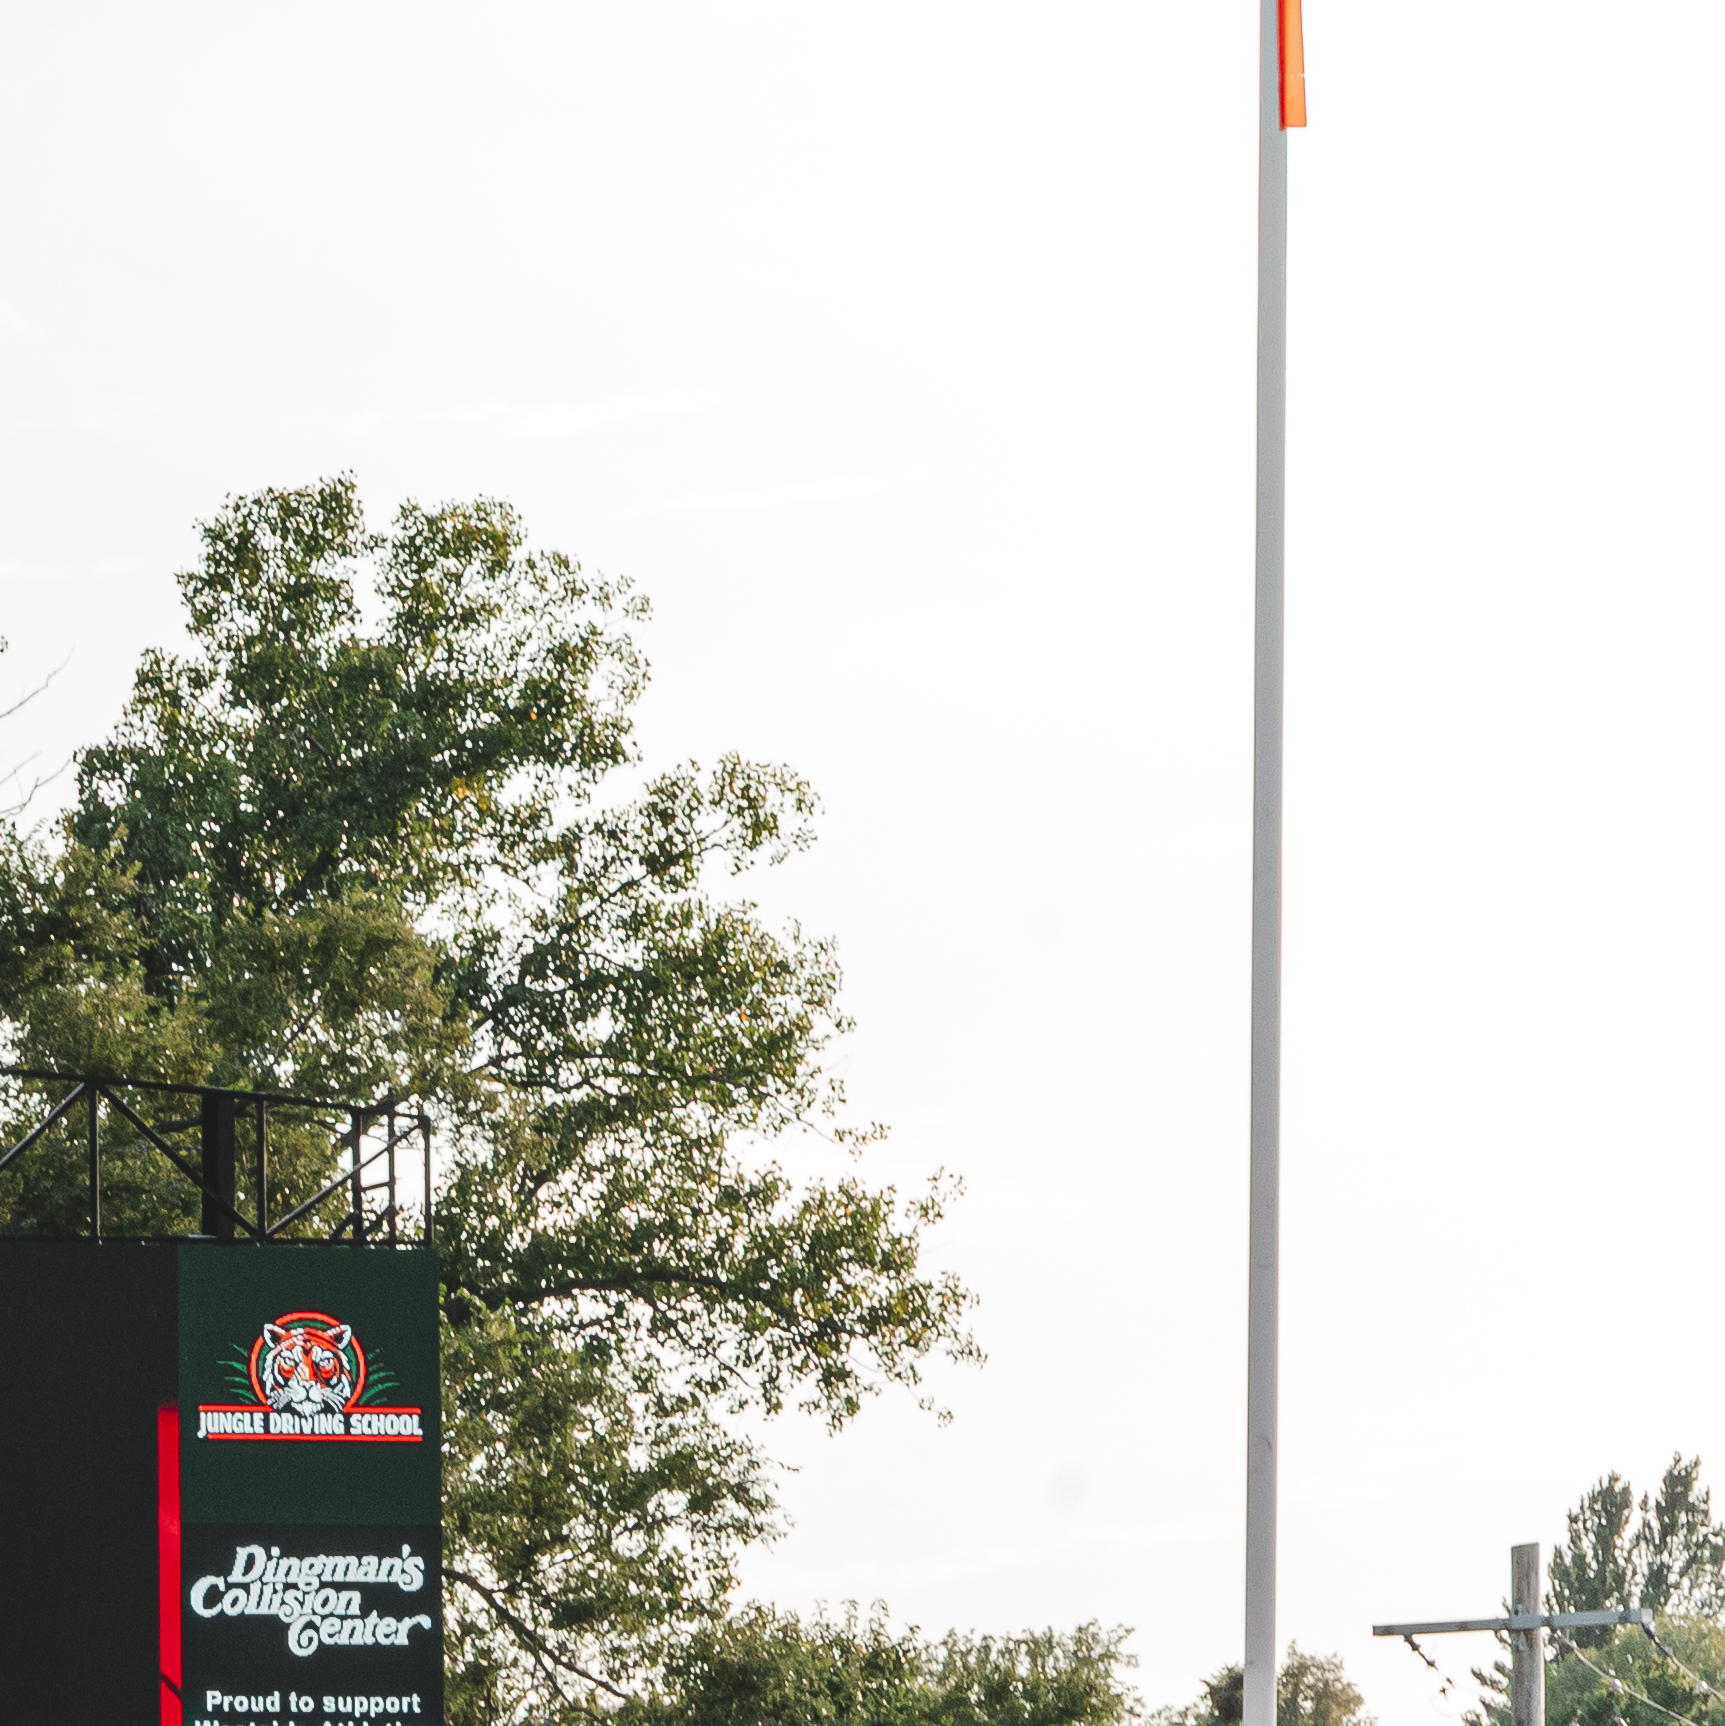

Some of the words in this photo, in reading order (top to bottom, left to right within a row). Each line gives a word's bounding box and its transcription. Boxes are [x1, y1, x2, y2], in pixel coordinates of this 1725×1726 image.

[197, 1412, 264, 1438] JUNGLE
[270, 1413, 345, 1434] DRIVING
[350, 1414, 423, 1436] SCHOOL
[228, 1543, 425, 1592] Dingman's
[190, 1575, 361, 1623] Collision
[287, 1611, 432, 1657] Center
[205, 1689, 281, 1713] Proud
[288, 1690, 315, 1713] to
[322, 1692, 422, 1717] support
